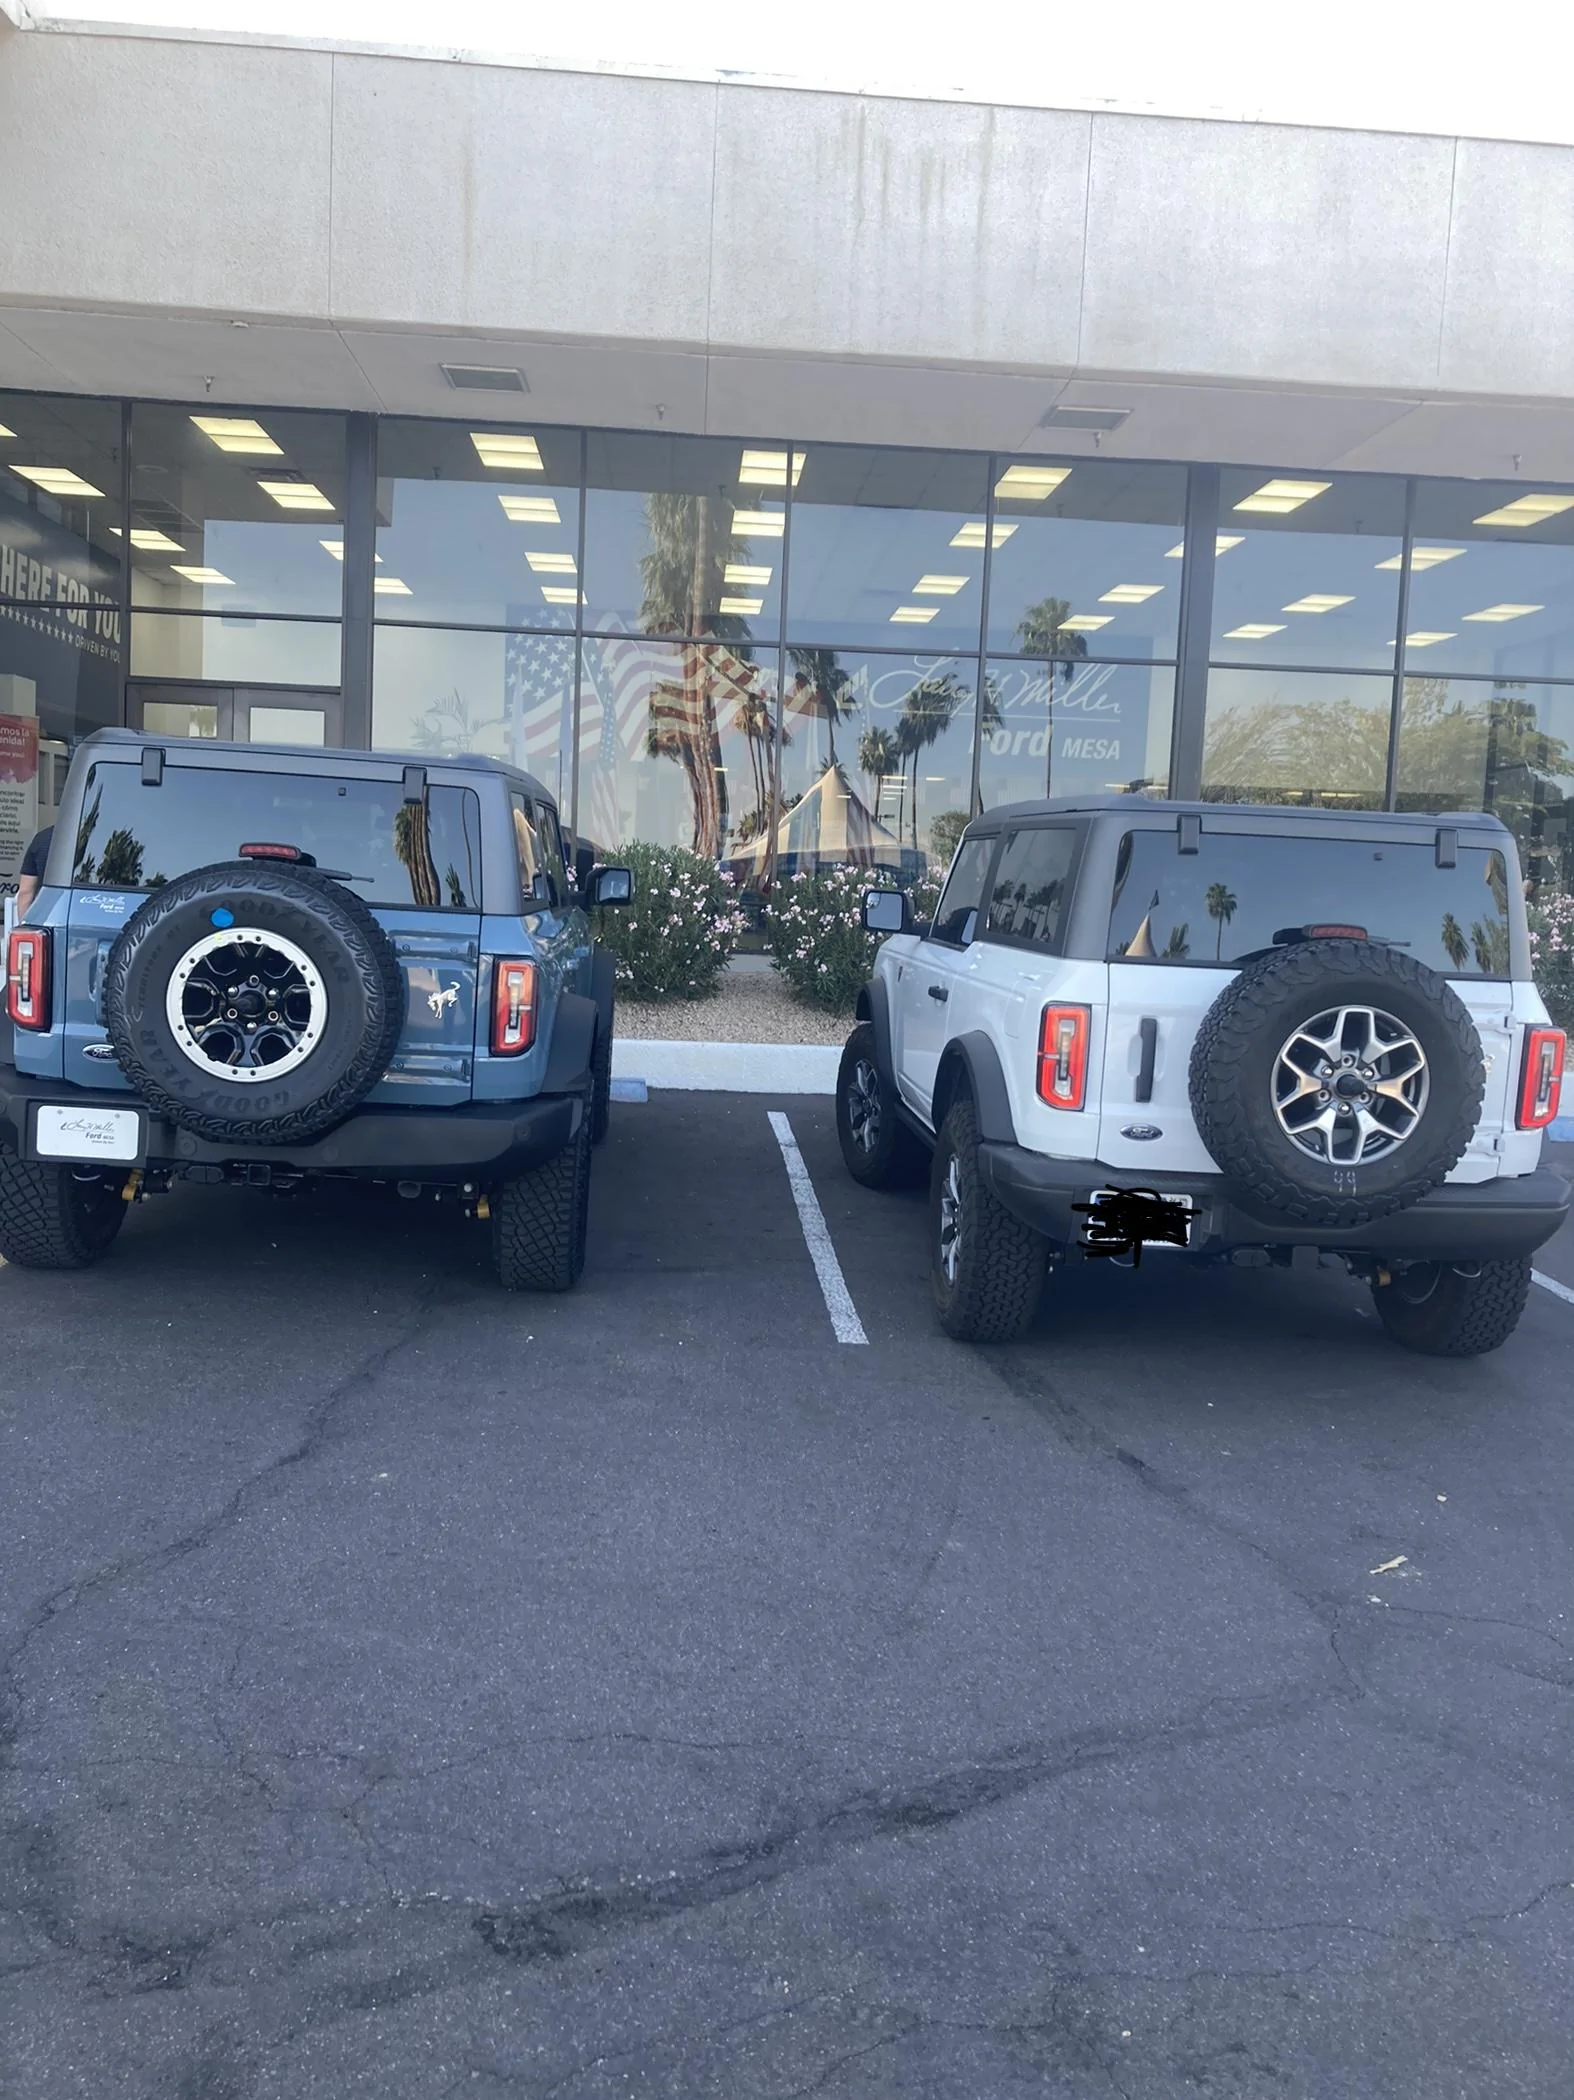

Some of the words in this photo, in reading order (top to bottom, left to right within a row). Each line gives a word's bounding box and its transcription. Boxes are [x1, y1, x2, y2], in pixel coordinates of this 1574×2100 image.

[1, 544, 52, 612] HERE
[56, 572, 90, 629] FOR
[75, 634, 99, 655] DRIVEN
[100, 644, 110, 657] BY
[1004, 661, 1123, 715] Miller
[1061, 736, 1122, 760] MESA
[85, 1131, 102, 1140] Ford
